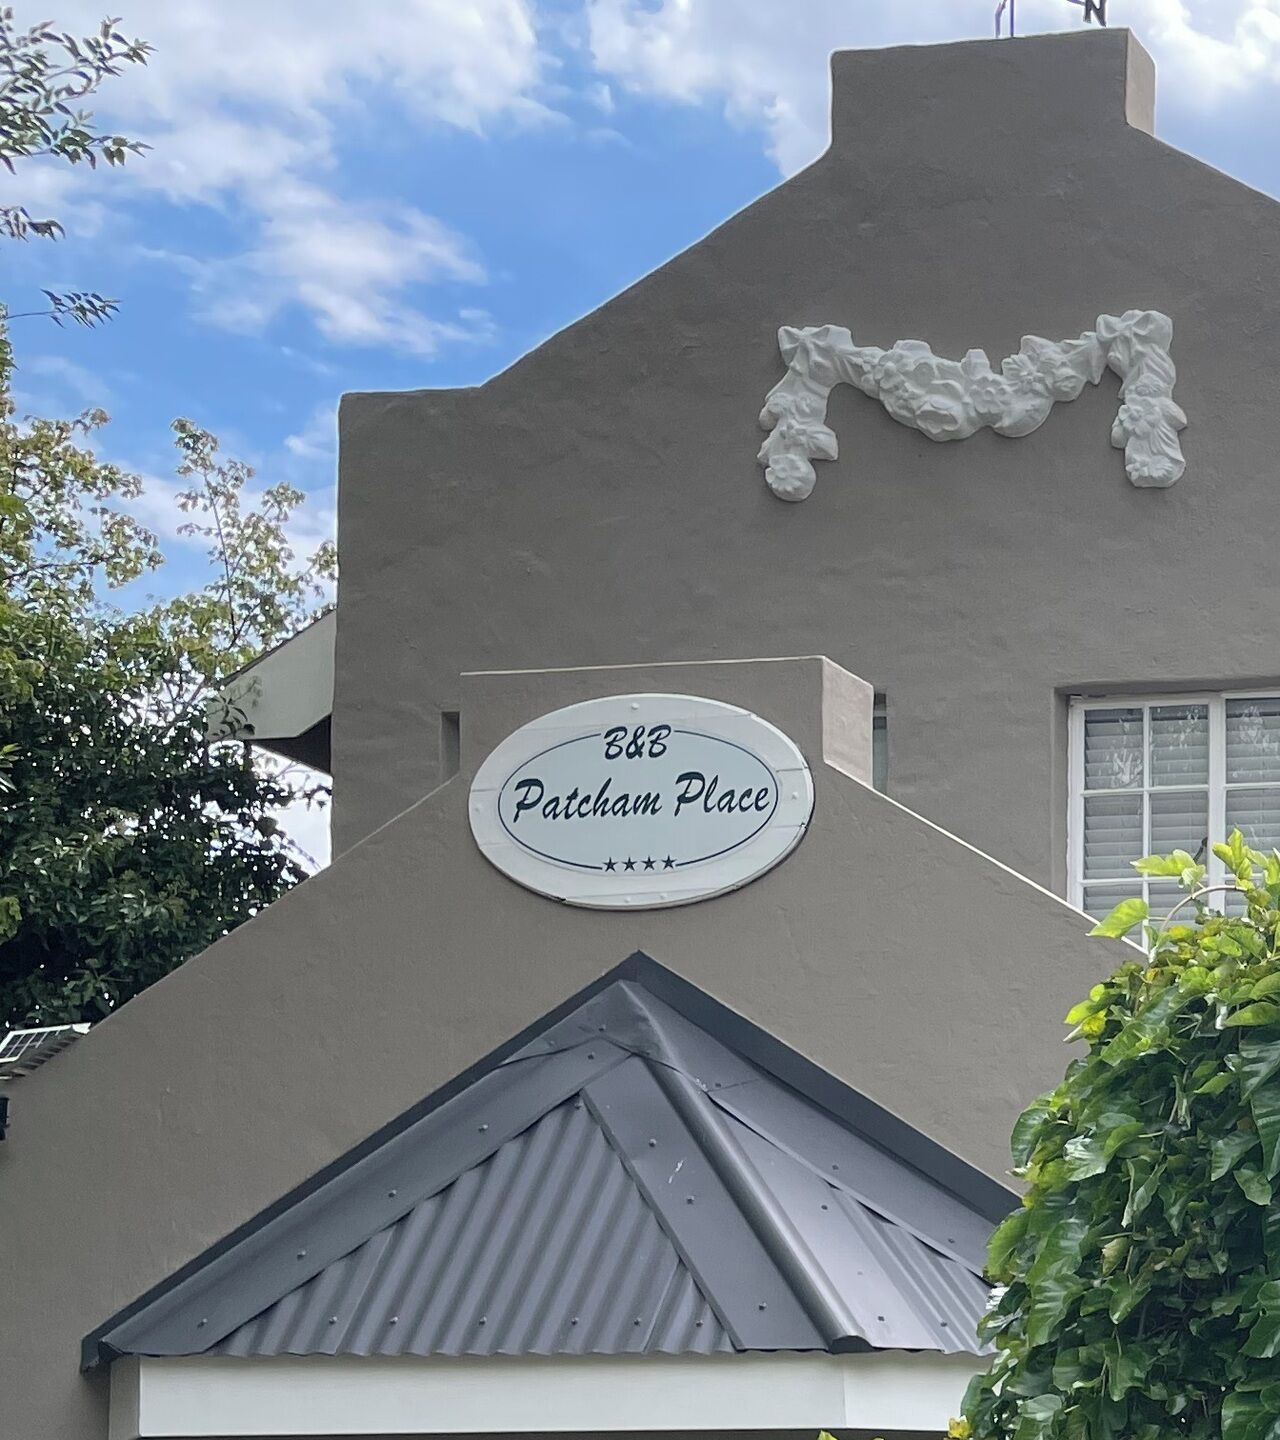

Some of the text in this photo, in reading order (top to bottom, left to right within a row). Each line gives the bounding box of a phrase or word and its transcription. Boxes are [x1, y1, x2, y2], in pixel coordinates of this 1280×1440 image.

[604, 724, 672, 760] B&B
[513, 771, 770, 823] Patcham Place
